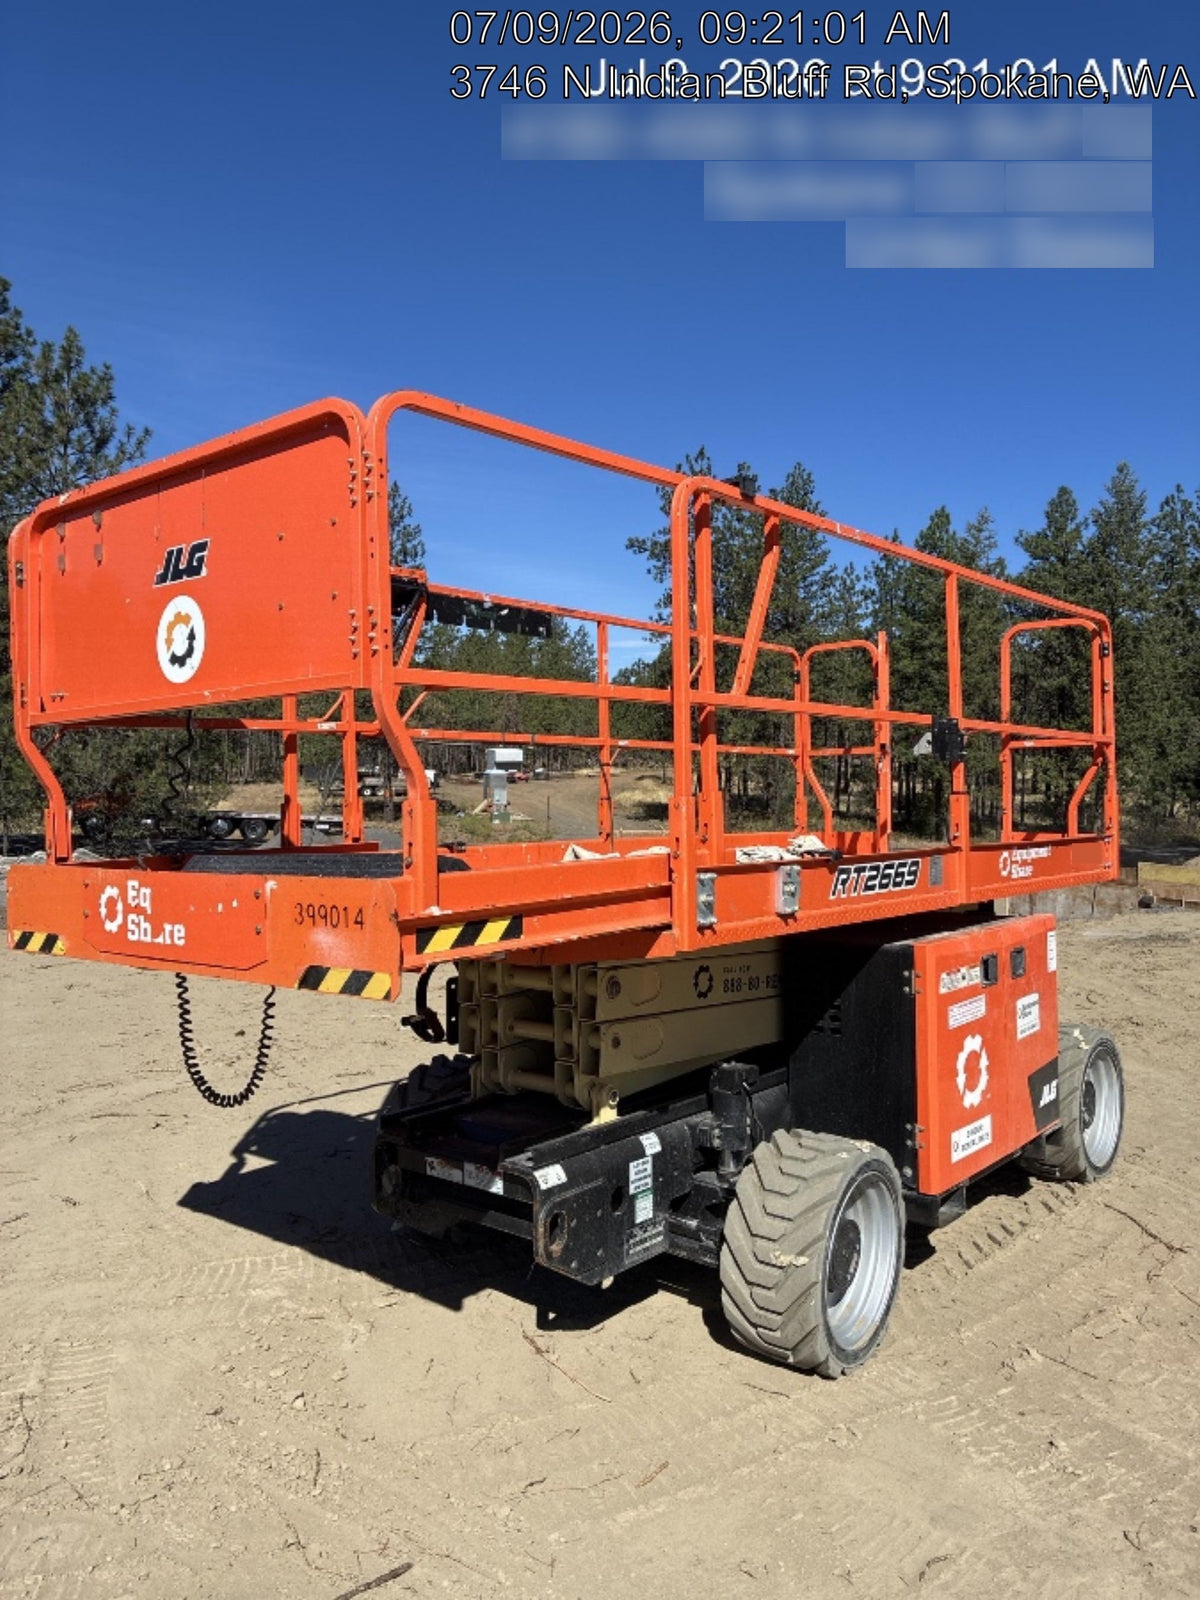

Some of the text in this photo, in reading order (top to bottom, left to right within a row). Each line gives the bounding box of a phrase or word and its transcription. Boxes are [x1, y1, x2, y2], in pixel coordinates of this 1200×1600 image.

[153, 538, 210, 588] JLG
[829, 859, 922, 900] RT2669
[294, 902, 365, 930] 399014
[1039, 1078, 1059, 1108] JLG
